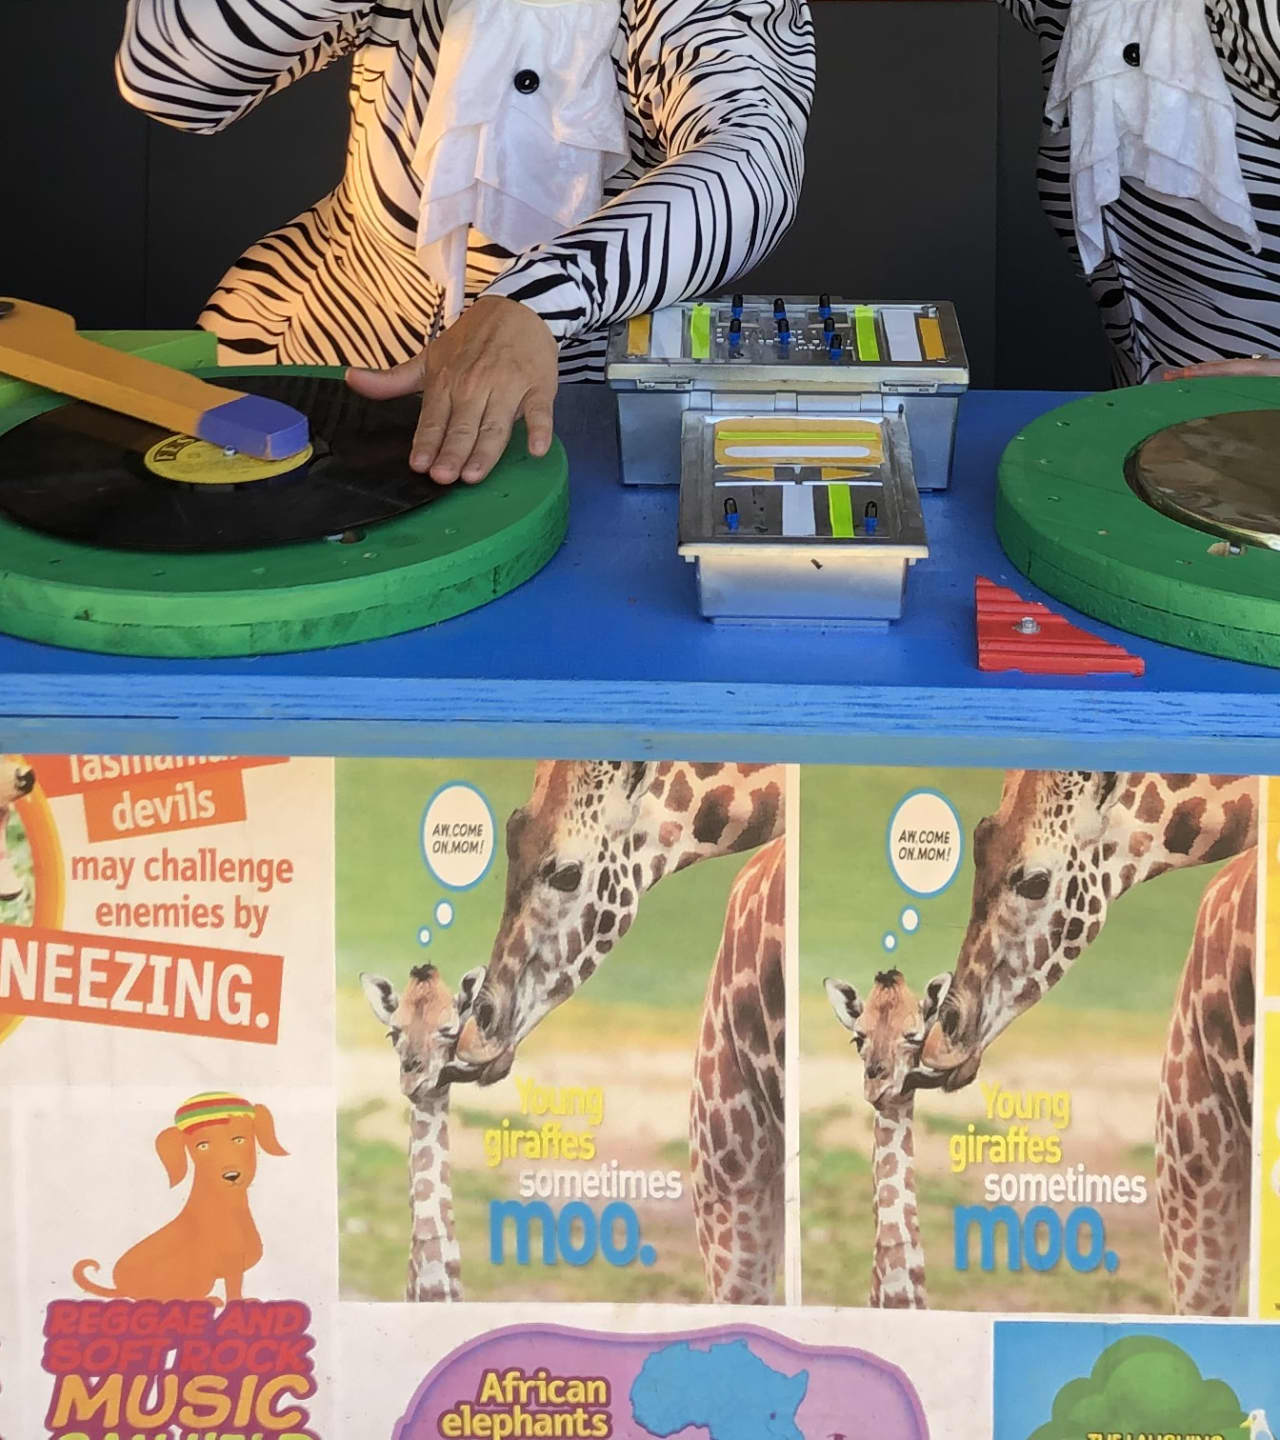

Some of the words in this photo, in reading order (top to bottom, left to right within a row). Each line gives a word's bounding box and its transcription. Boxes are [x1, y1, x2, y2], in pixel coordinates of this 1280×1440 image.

[111, 781, 216, 832] devils
[451, 840, 484, 855] MOM!
[452, 823, 484, 837] COME
[919, 830, 951, 844] COME
[71, 855, 135, 890] may
[144, 848, 293, 892] challenge
[917, 847, 951, 862] MOM!
[96, 894, 224, 928] enemies
[234, 894, 269, 938] by
[515, 1077, 604, 1126] Young
[980, 1081, 1070, 1129] Young
[484, 1118, 596, 1168] giraffes
[949, 1123, 1062, 1173] giraffes
[520, 1160, 683, 1199] sometimes
[984, 1163, 1147, 1203] sometimes
[489, 1199, 657, 1268] moo.
[953, 1204, 1119, 1273] moo.
[50, 1305, 207, 1335] REGGAE
[217, 1305, 304, 1335] AND
[51, 1338, 172, 1373] SOFT
[179, 1339, 312, 1373] ROCK
[52, 1374, 310, 1429] MUSIC
[480, 1372, 607, 1404] African
[442, 1407, 609, 1440] elephants
